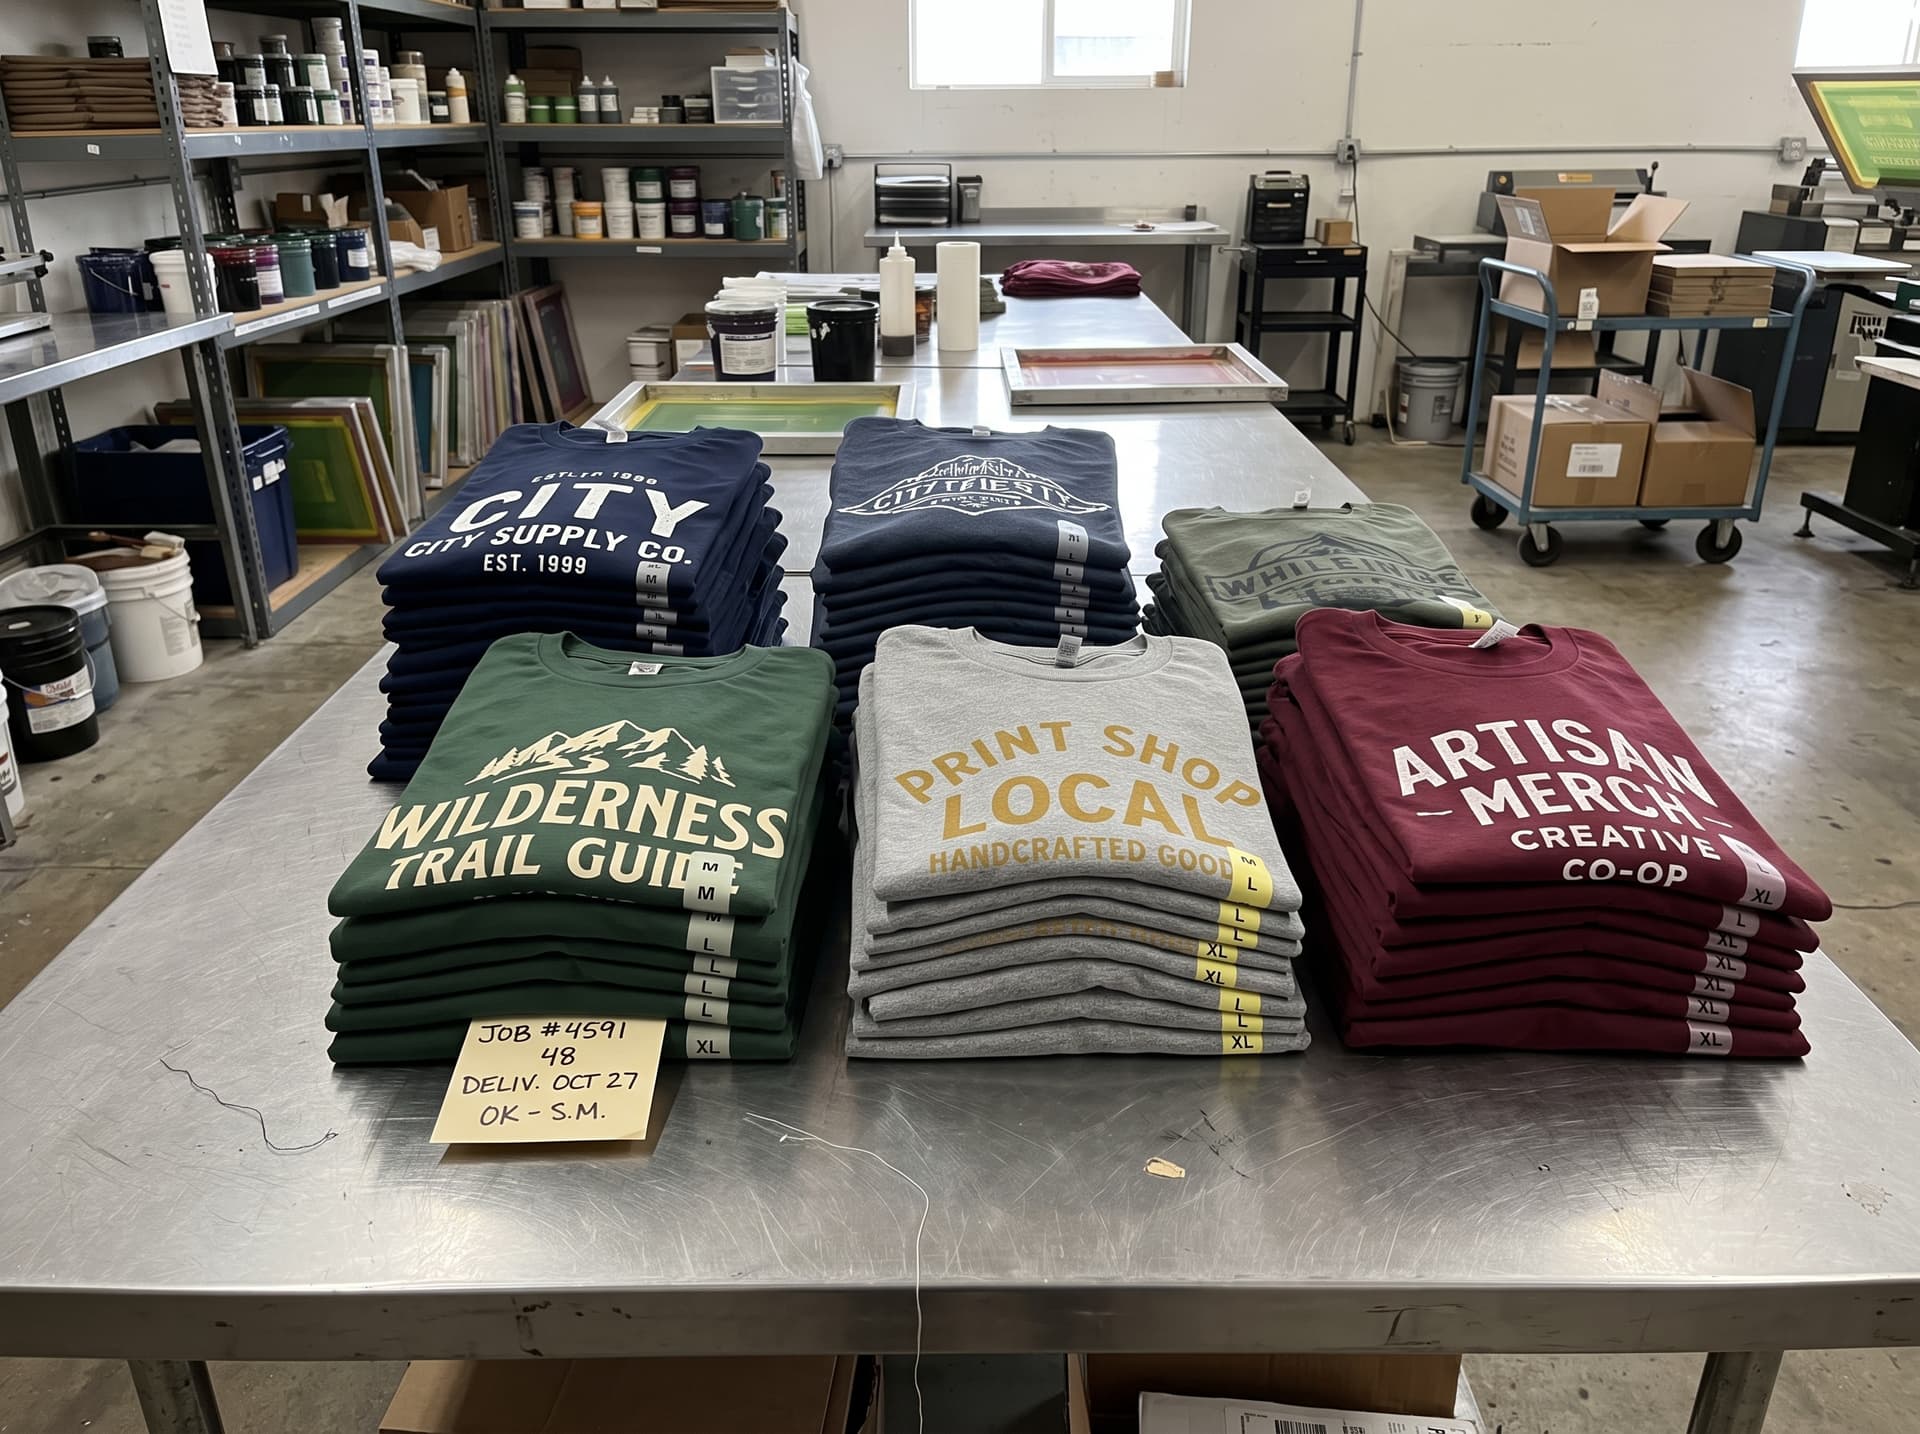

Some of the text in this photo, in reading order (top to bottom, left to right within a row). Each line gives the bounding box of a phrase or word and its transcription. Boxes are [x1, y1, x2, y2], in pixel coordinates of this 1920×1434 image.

[449, 482, 710, 538] CITY
[403, 524, 693, 565] CITY SUPPLY CO.
[483, 553, 587, 574] EST. 1999
[645, 574, 657, 585] M
[1065, 567, 1073, 577] L
[1065, 609, 1073, 618] L
[894, 721, 1262, 808] PRINT SHOP
[1392, 718, 1718, 808] ARTISAN
[1459, 772, 1706, 831] MERCH
[942, 772, 1236, 848] LOCAL
[374, 779, 788, 859] WILDERNESS
[1510, 824, 1721, 861] CREATIVE
[385, 834, 542, 891] TRAIL
[929, 836, 1147, 875] HANDCRAFTED
[702, 862, 719, 872] M
[1562, 858, 1688, 888] CO-OP
[1247, 877, 1258, 891] L
[697, 885, 715, 901] M
[1750, 887, 1774, 905] XL
[1235, 908, 1245, 923] L
[1736, 912, 1746, 928] L
[1233, 929, 1244, 942] L
[1716, 934, 1739, 949] XL
[703, 937, 716, 952] L
[1205, 943, 1228, 959] XL
[710, 959, 721, 974] L
[1715, 955, 1737, 971] XL
[1203, 969, 1225, 985] XL
[1703, 976, 1726, 992] XL
[701, 979, 713, 995] L
[701, 1002, 713, 1018] L
[1234, 998, 1245, 1012] L
[1697, 1000, 1720, 1015] XL
[1238, 1014, 1248, 1028] L
[478, 1021, 627, 1043] JOB #4591
[1699, 1031, 1723, 1047] XL
[696, 1039, 721, 1055] XL
[1231, 1035, 1254, 1050] XL
[541, 1046, 576, 1066] 48
[462, 1072, 639, 1095] DELIV. OCT 27
[479, 1104, 520, 1126] OK
[551, 1101, 606, 1121] S.M.
